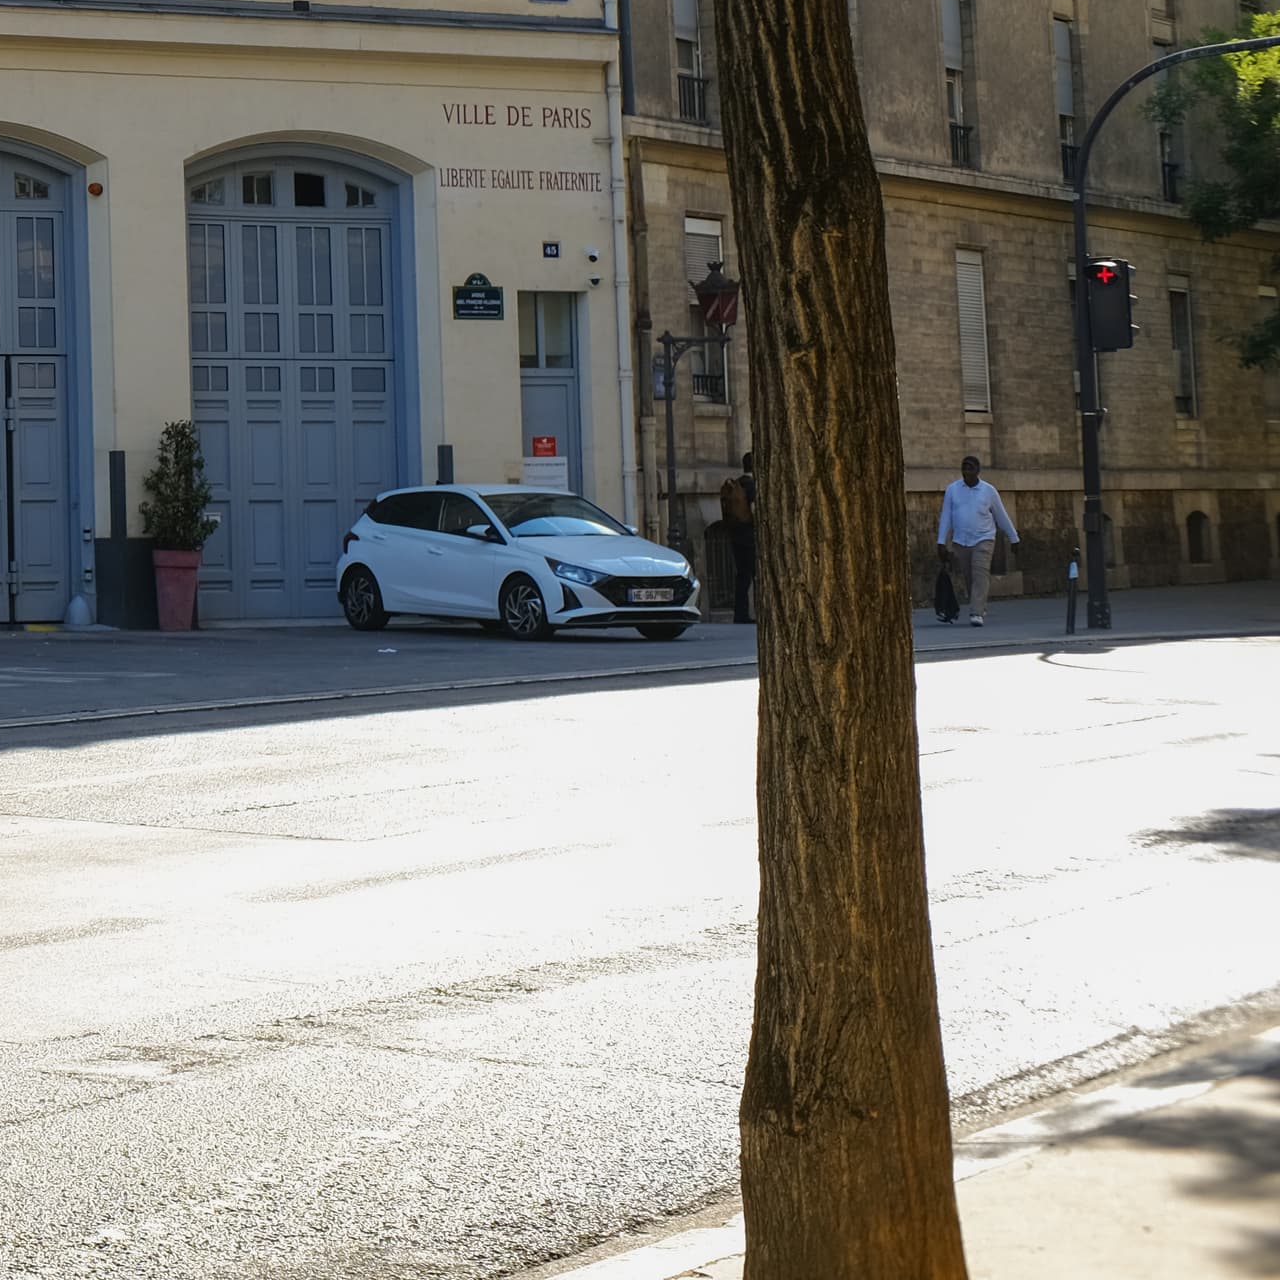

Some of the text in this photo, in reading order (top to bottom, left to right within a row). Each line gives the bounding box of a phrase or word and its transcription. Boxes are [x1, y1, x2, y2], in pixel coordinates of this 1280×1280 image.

[442, 103, 592, 129] VILLE DE PARIS
[440, 167, 602, 192] LIBERTE EGALITE FRATERNITE
[545, 245, 557, 255] 45
